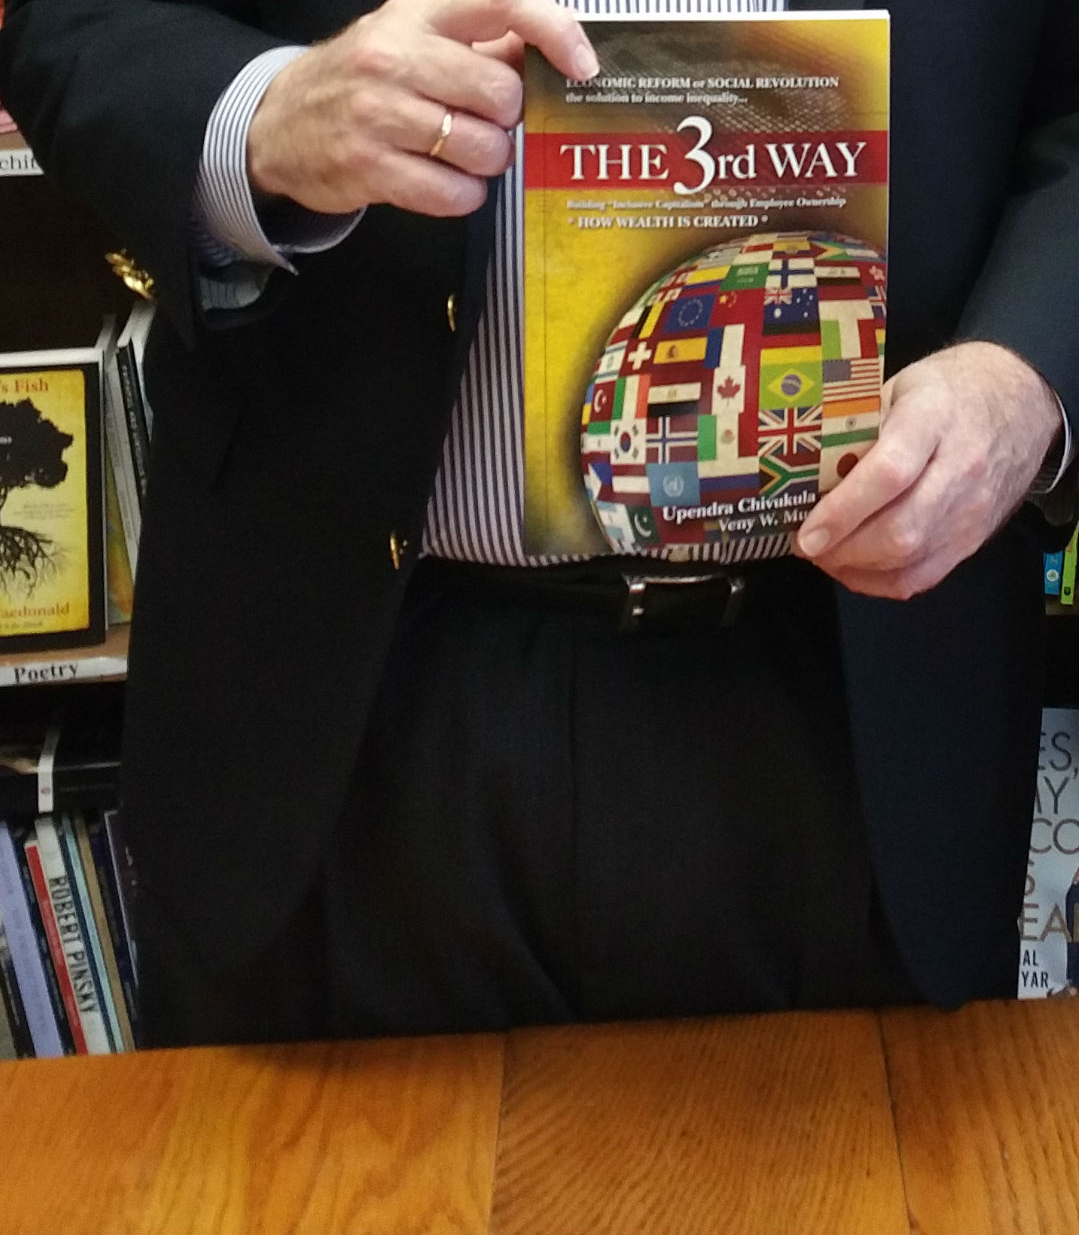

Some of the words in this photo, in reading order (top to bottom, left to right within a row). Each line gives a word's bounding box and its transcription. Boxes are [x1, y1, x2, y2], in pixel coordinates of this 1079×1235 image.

[566, 77, 636, 89] ECONOMIC
[638, 77, 691, 89] REFORM
[693, 80, 705, 89] or
[707, 77, 753, 89] SOCIAL
[756, 76, 840, 89] REVOLUTION
[565, 93, 583, 103] the
[585, 93, 629, 103] solution
[631, 94, 643, 103] to
[645, 92, 684, 103] income
[560, 143, 670, 181] THE
[673, 116, 758, 196] 3rd
[765, 141, 867, 179] WAY
[567, 199, 605, 211] Building
[711, 198, 748, 211] through
[750, 198, 795, 211] Employee
[796, 196, 847, 209] Ownership
[577, 215, 613, 228] HOW
[616, 216, 674, 228] WEALTH
[677, 216, 690, 227] IS
[692, 214, 759, 227] CREATED
[15, 377, 49, 393] Fish
[662, 503, 734, 522] Upendra
[738, 491, 816, 514] Chivukula
[718, 516, 755, 533] Veny
[758, 514, 779, 526] W.
[14, 662, 79, 684] Poetry
[49, 876, 83, 954] ROBERT
[66, 950, 100, 1014] PINSKY
